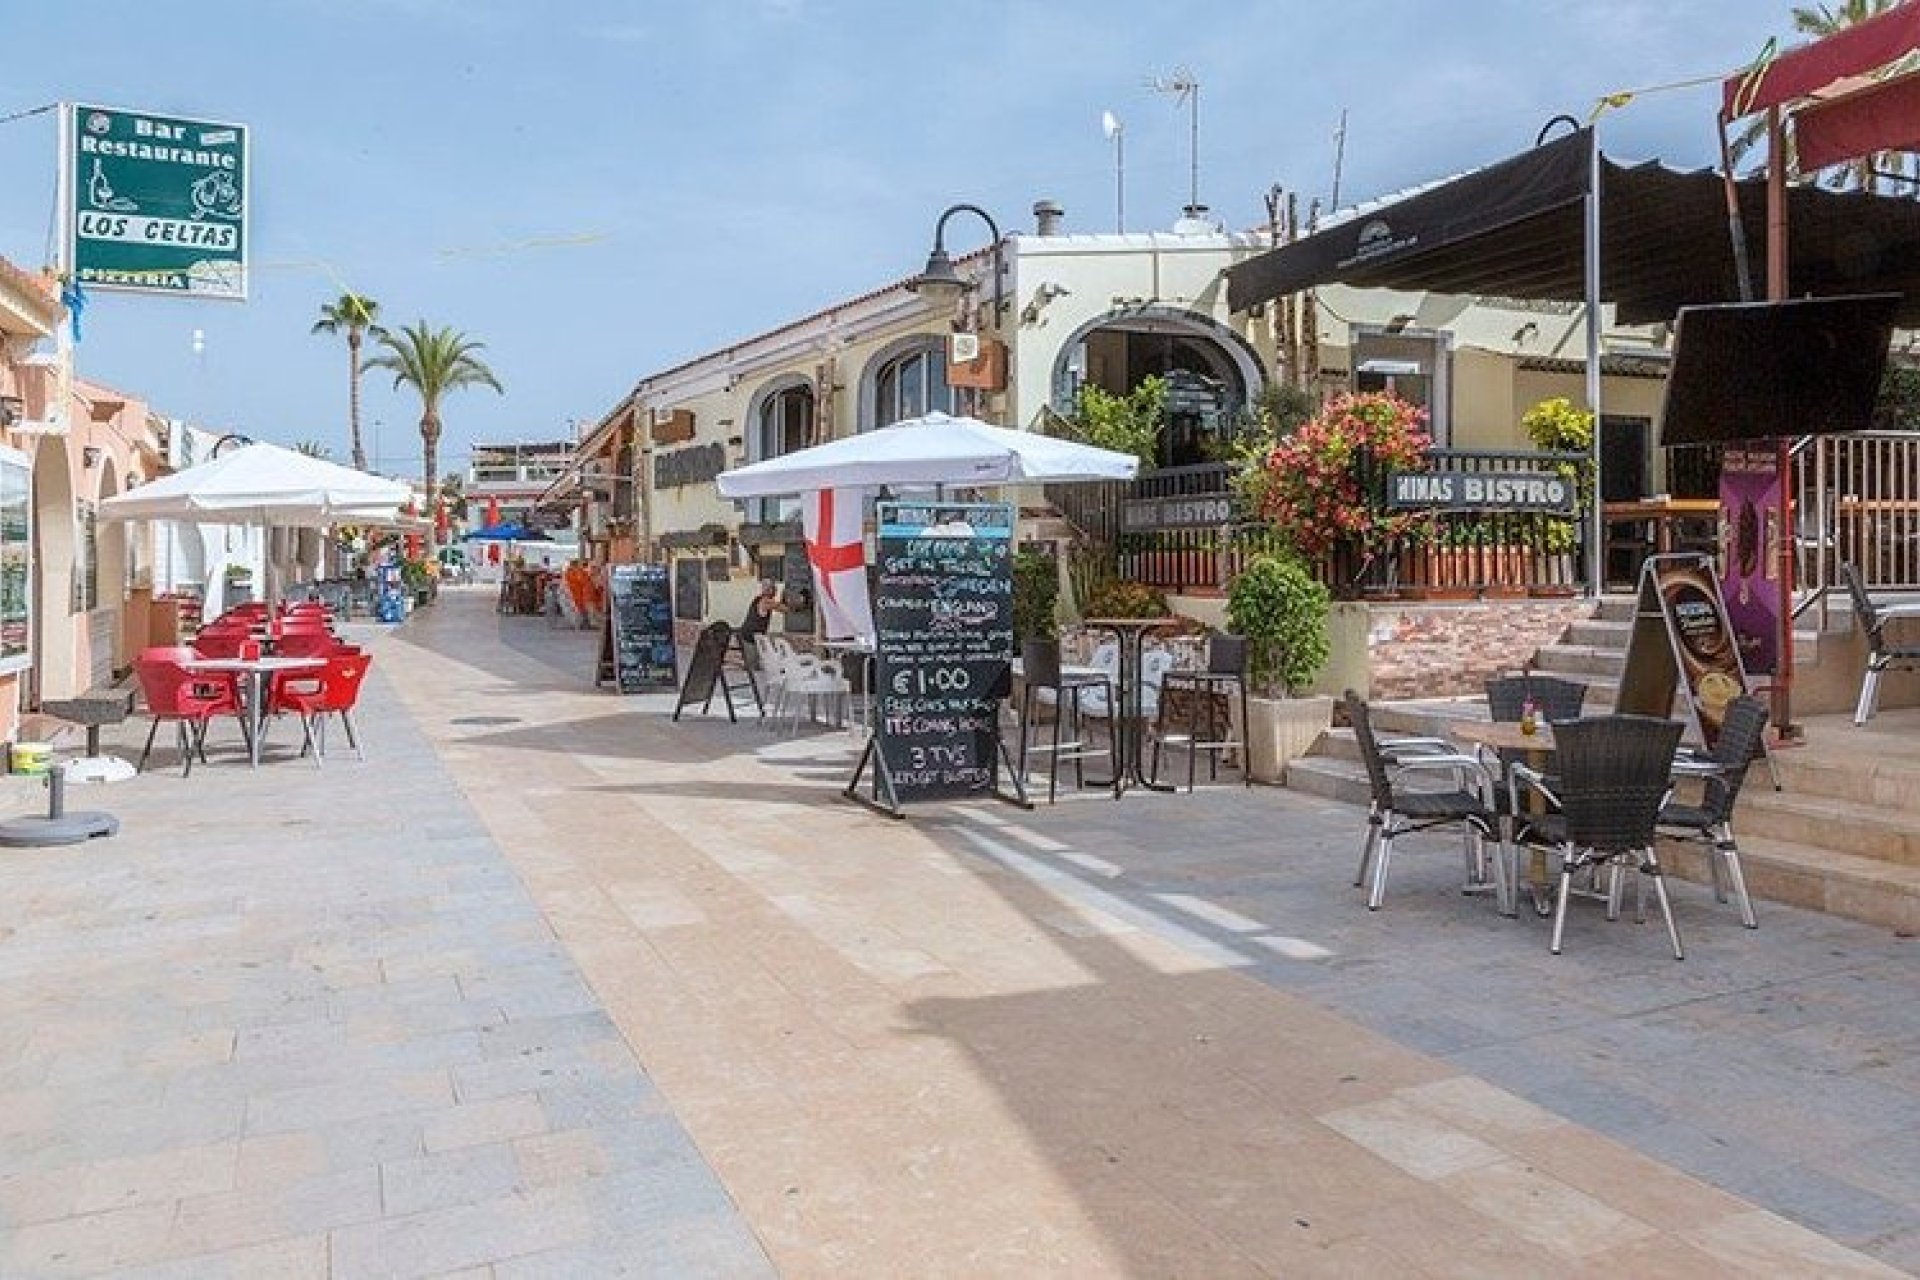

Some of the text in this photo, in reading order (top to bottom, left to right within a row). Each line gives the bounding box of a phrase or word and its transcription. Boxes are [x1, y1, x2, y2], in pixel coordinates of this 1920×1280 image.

[135, 119, 187, 140] Bar
[82, 135, 236, 170] Restaurante
[82, 215, 233, 247] LOS CELTAS
[1465, 477, 1565, 503] BISTRO
[1163, 500, 1229, 523] BISTRO
[910, 745, 927, 769] 3
